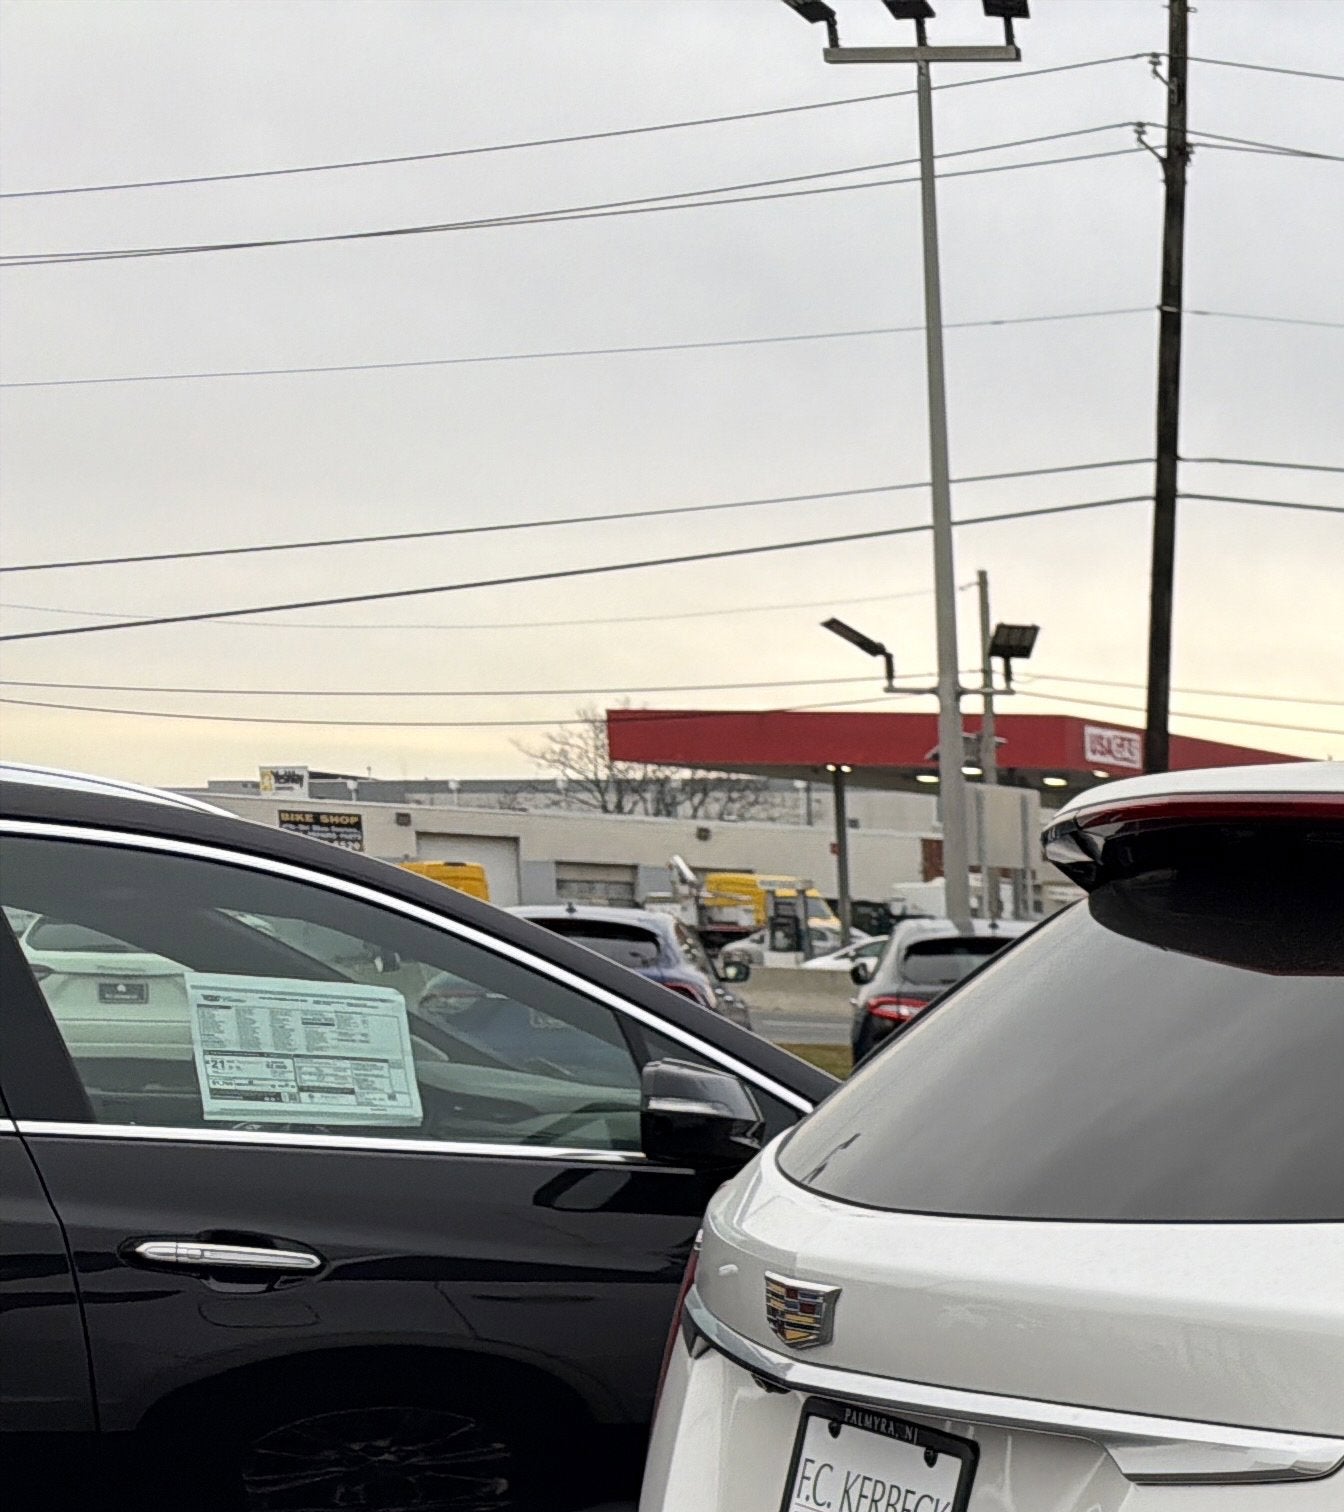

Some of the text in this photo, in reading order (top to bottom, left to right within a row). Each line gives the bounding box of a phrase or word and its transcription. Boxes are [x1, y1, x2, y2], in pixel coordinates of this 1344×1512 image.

[281, 812, 359, 825] BIKE SHOP
[796, 1457, 834, 1510] F.C.
